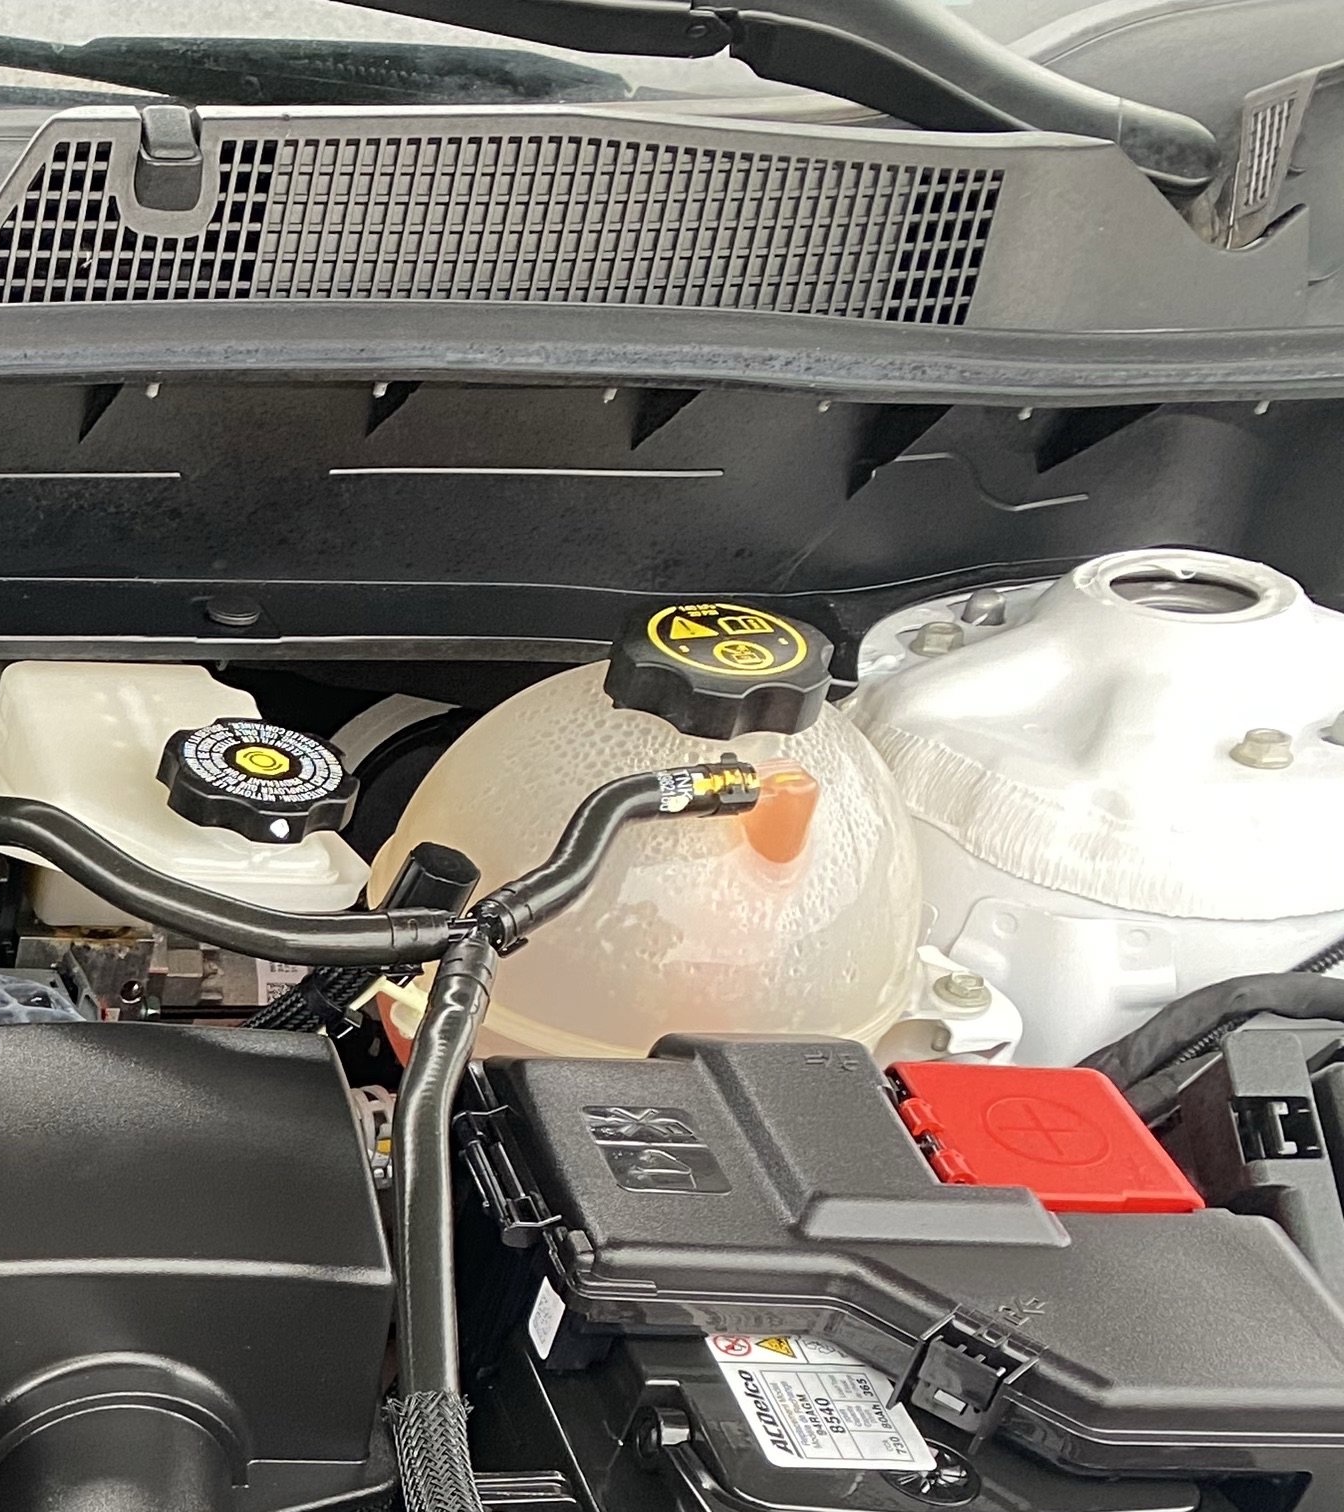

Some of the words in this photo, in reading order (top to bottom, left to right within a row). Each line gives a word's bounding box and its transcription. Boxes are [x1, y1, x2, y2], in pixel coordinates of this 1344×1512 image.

[854, 1377, 875, 1397] 365
[811, 1396, 847, 1433] 8540
[868, 1403, 893, 1429] 80Ah
[888, 1435, 908, 1454] 730
